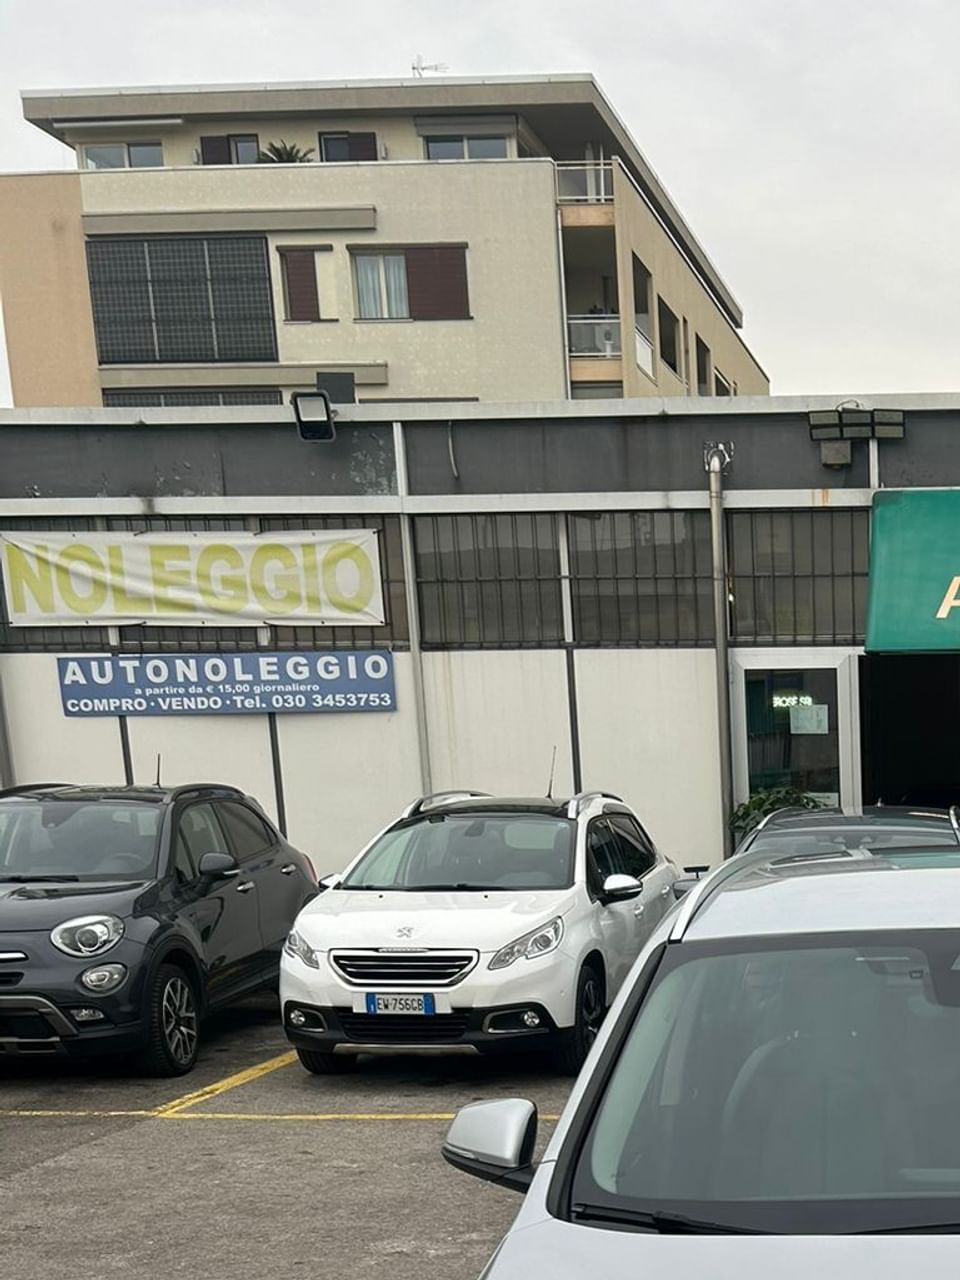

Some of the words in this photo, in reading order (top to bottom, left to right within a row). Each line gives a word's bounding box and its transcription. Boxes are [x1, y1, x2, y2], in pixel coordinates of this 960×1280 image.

[5, 541, 374, 615] NOLEGGIO
[63, 655, 389, 685] AUTONOLEGGIO
[145, 685, 186, 696] partire
[188, 685, 203, 694] da
[218, 684, 250, 694] 15,00
[253, 683, 320, 694] giornaliero
[66, 698, 147, 712] COMPRO
[158, 696, 222, 710] VENDO
[232, 696, 266, 708] Tel.
[271, 694, 307, 708] 030
[312, 693, 392, 707] 3453753
